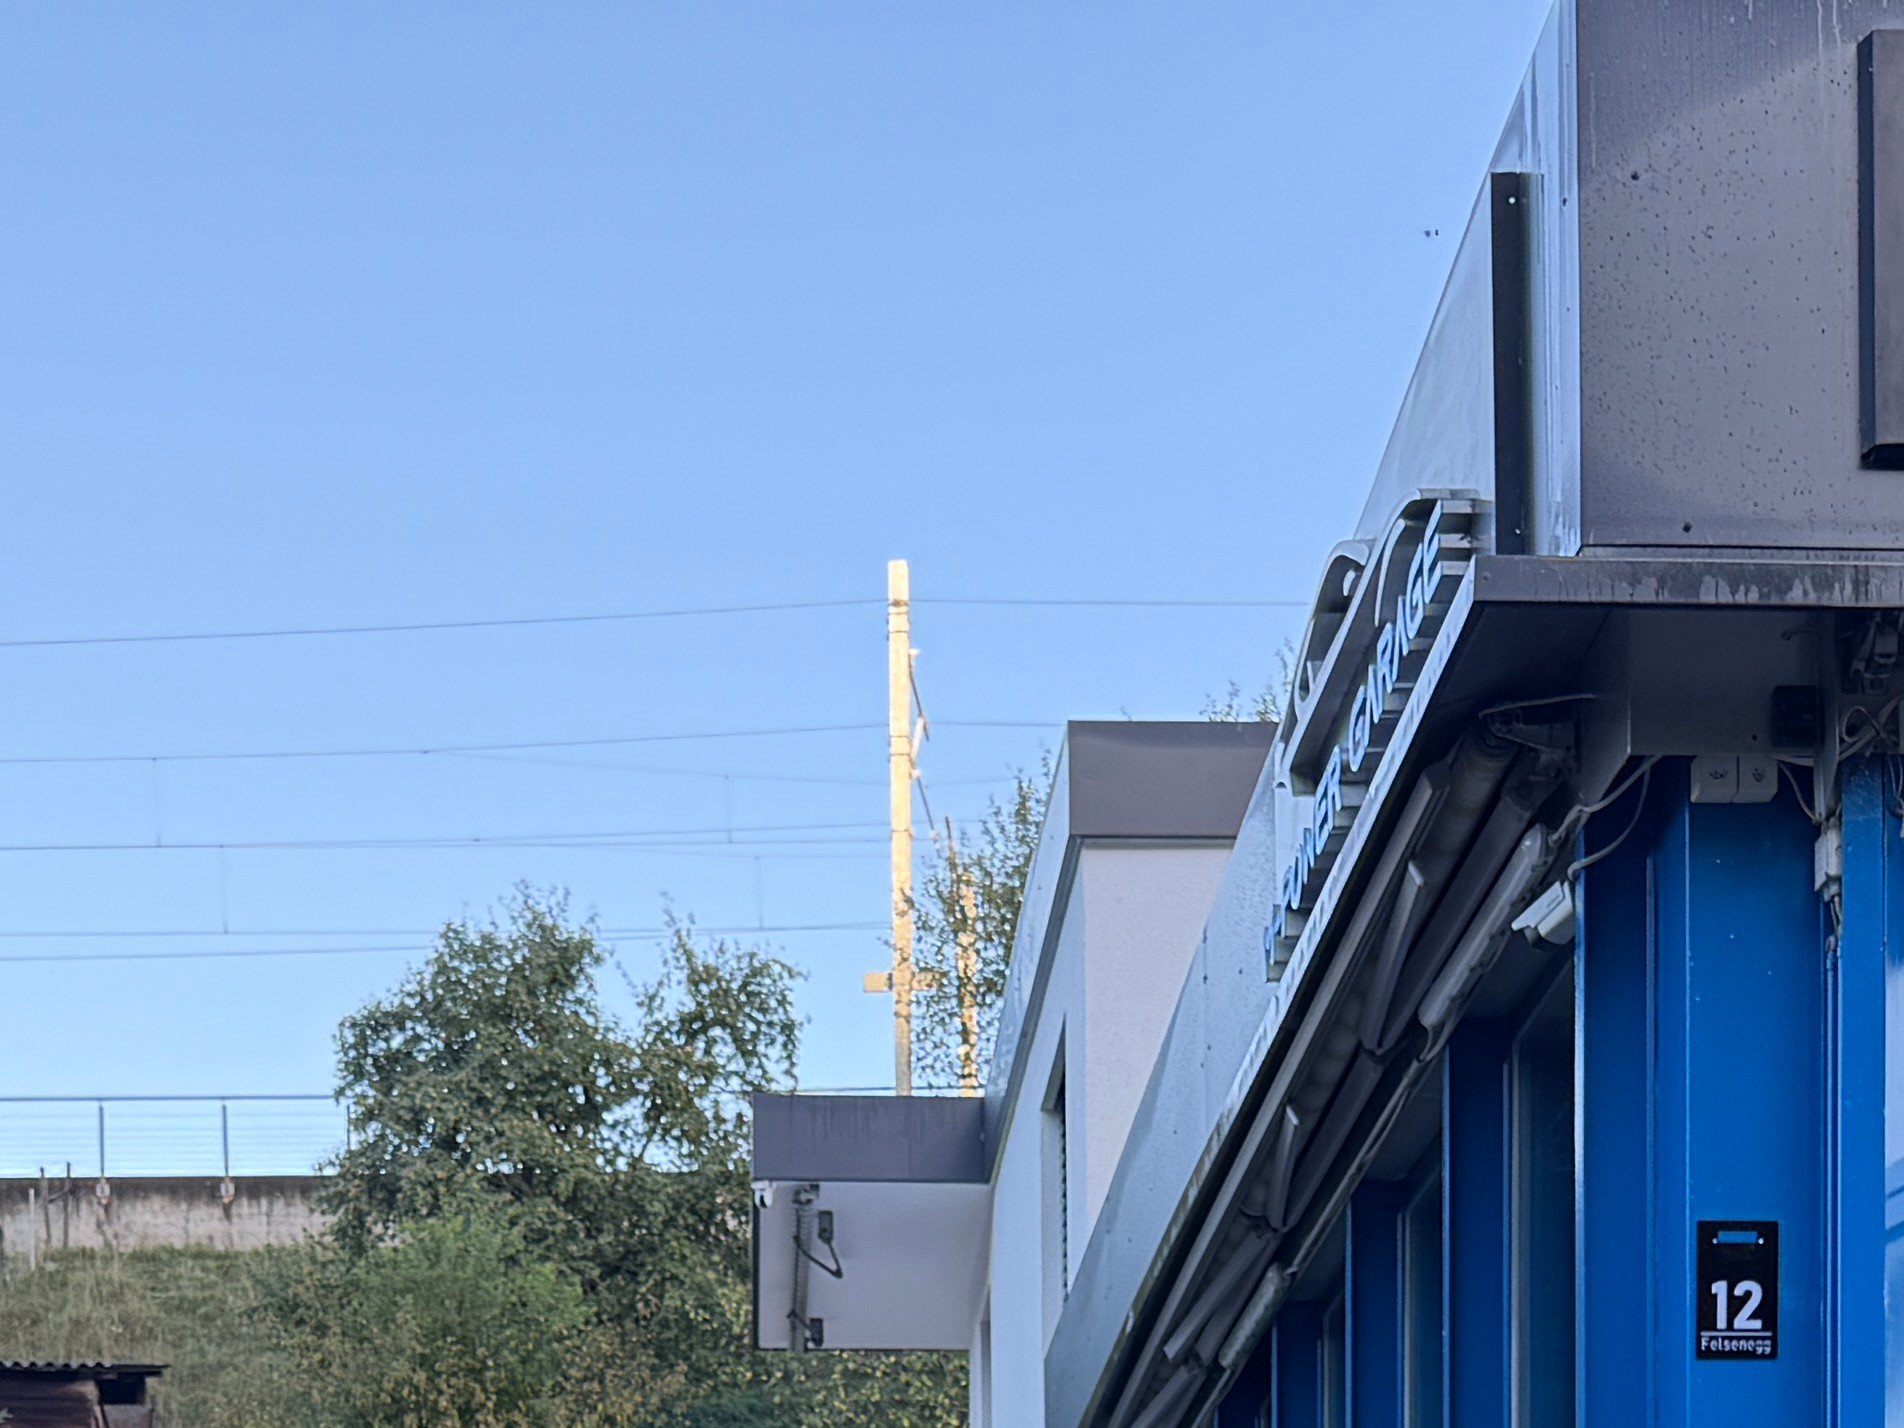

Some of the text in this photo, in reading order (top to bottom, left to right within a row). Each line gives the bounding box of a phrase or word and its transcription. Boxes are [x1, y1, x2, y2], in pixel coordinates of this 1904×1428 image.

[1348, 498, 1442, 772] GARAGE
[1711, 1280, 1763, 1329] 12
[1700, 1337, 1772, 1355] Felsenegg
